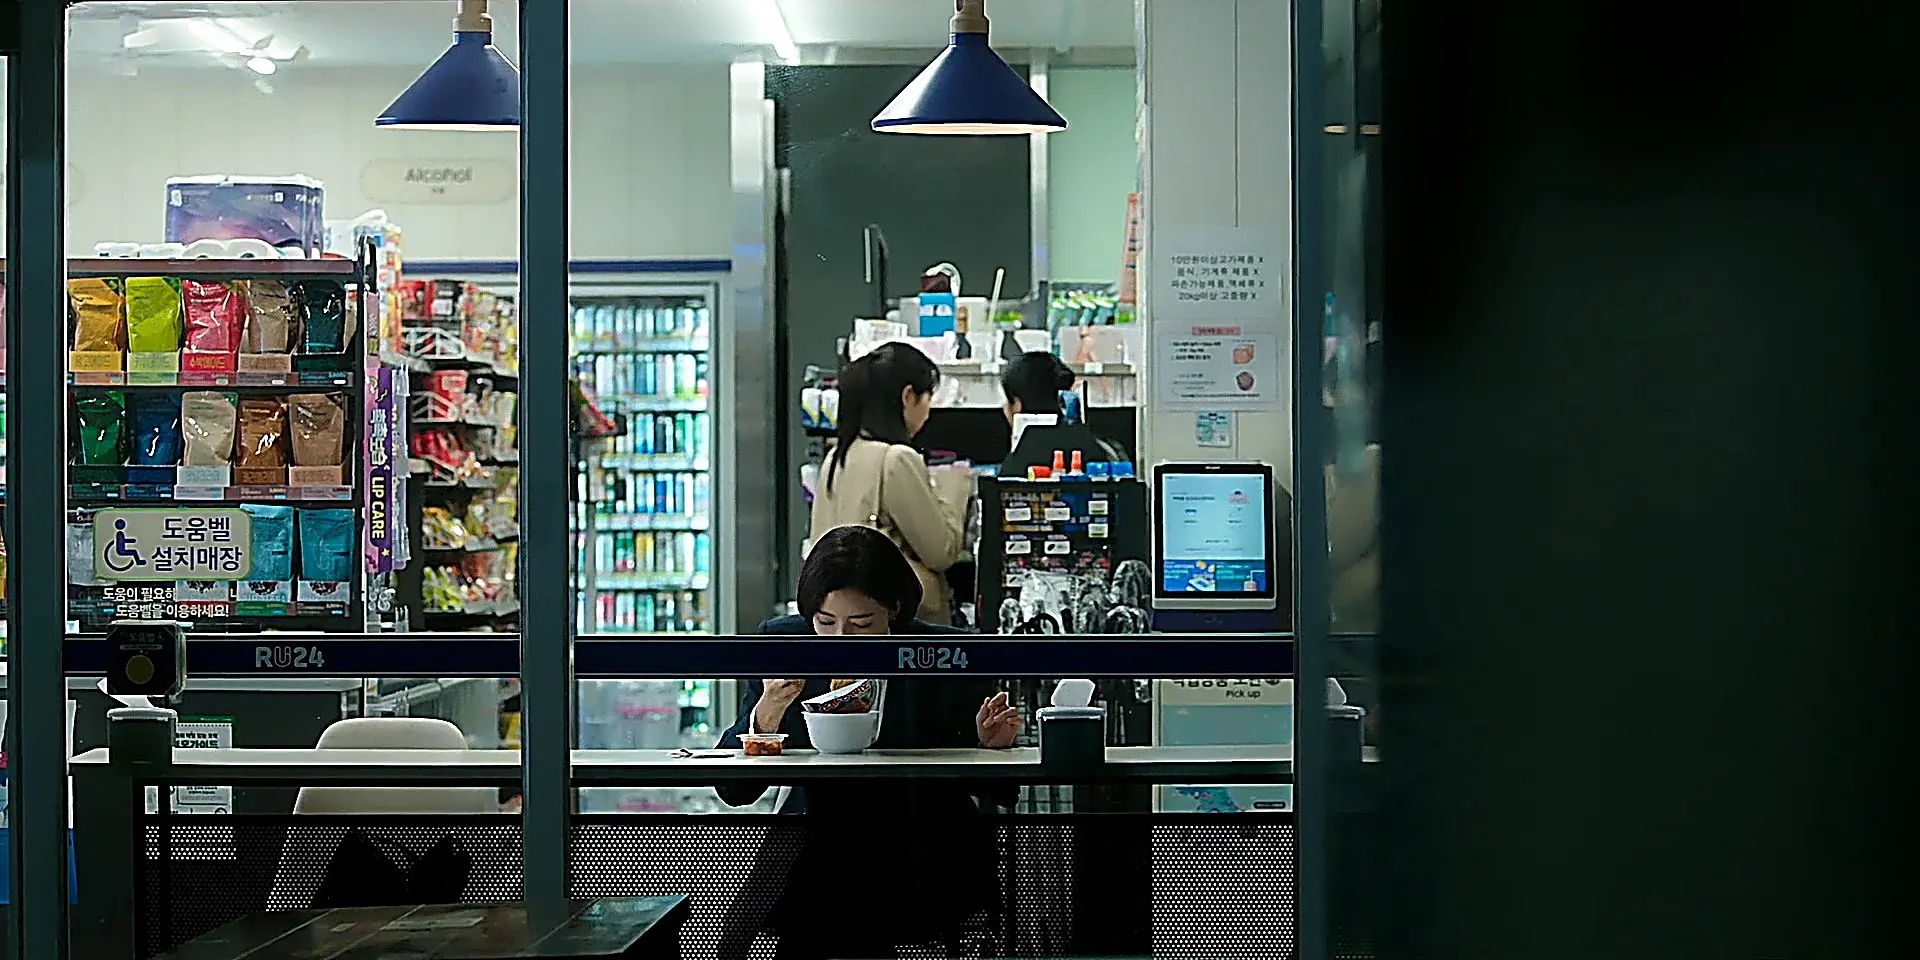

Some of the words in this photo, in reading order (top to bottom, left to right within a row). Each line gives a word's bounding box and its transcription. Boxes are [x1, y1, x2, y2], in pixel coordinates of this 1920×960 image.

[404, 168, 472, 182] Alcohol
[371, 476, 385, 499] LIP
[162, 517, 231, 542] 도움벨
[371, 501, 385, 539] CARE
[151, 546, 243, 572] 설치매장
[102, 587, 138, 601] 도움이
[140, 587, 176, 602] 필요하
[166, 604, 230, 618] 이용하세요!
[255, 646, 325, 668] RU24
[898, 647, 969, 669] RU24
[1225, 689, 1244, 698] Pick
[1247, 690, 1261, 699] up
